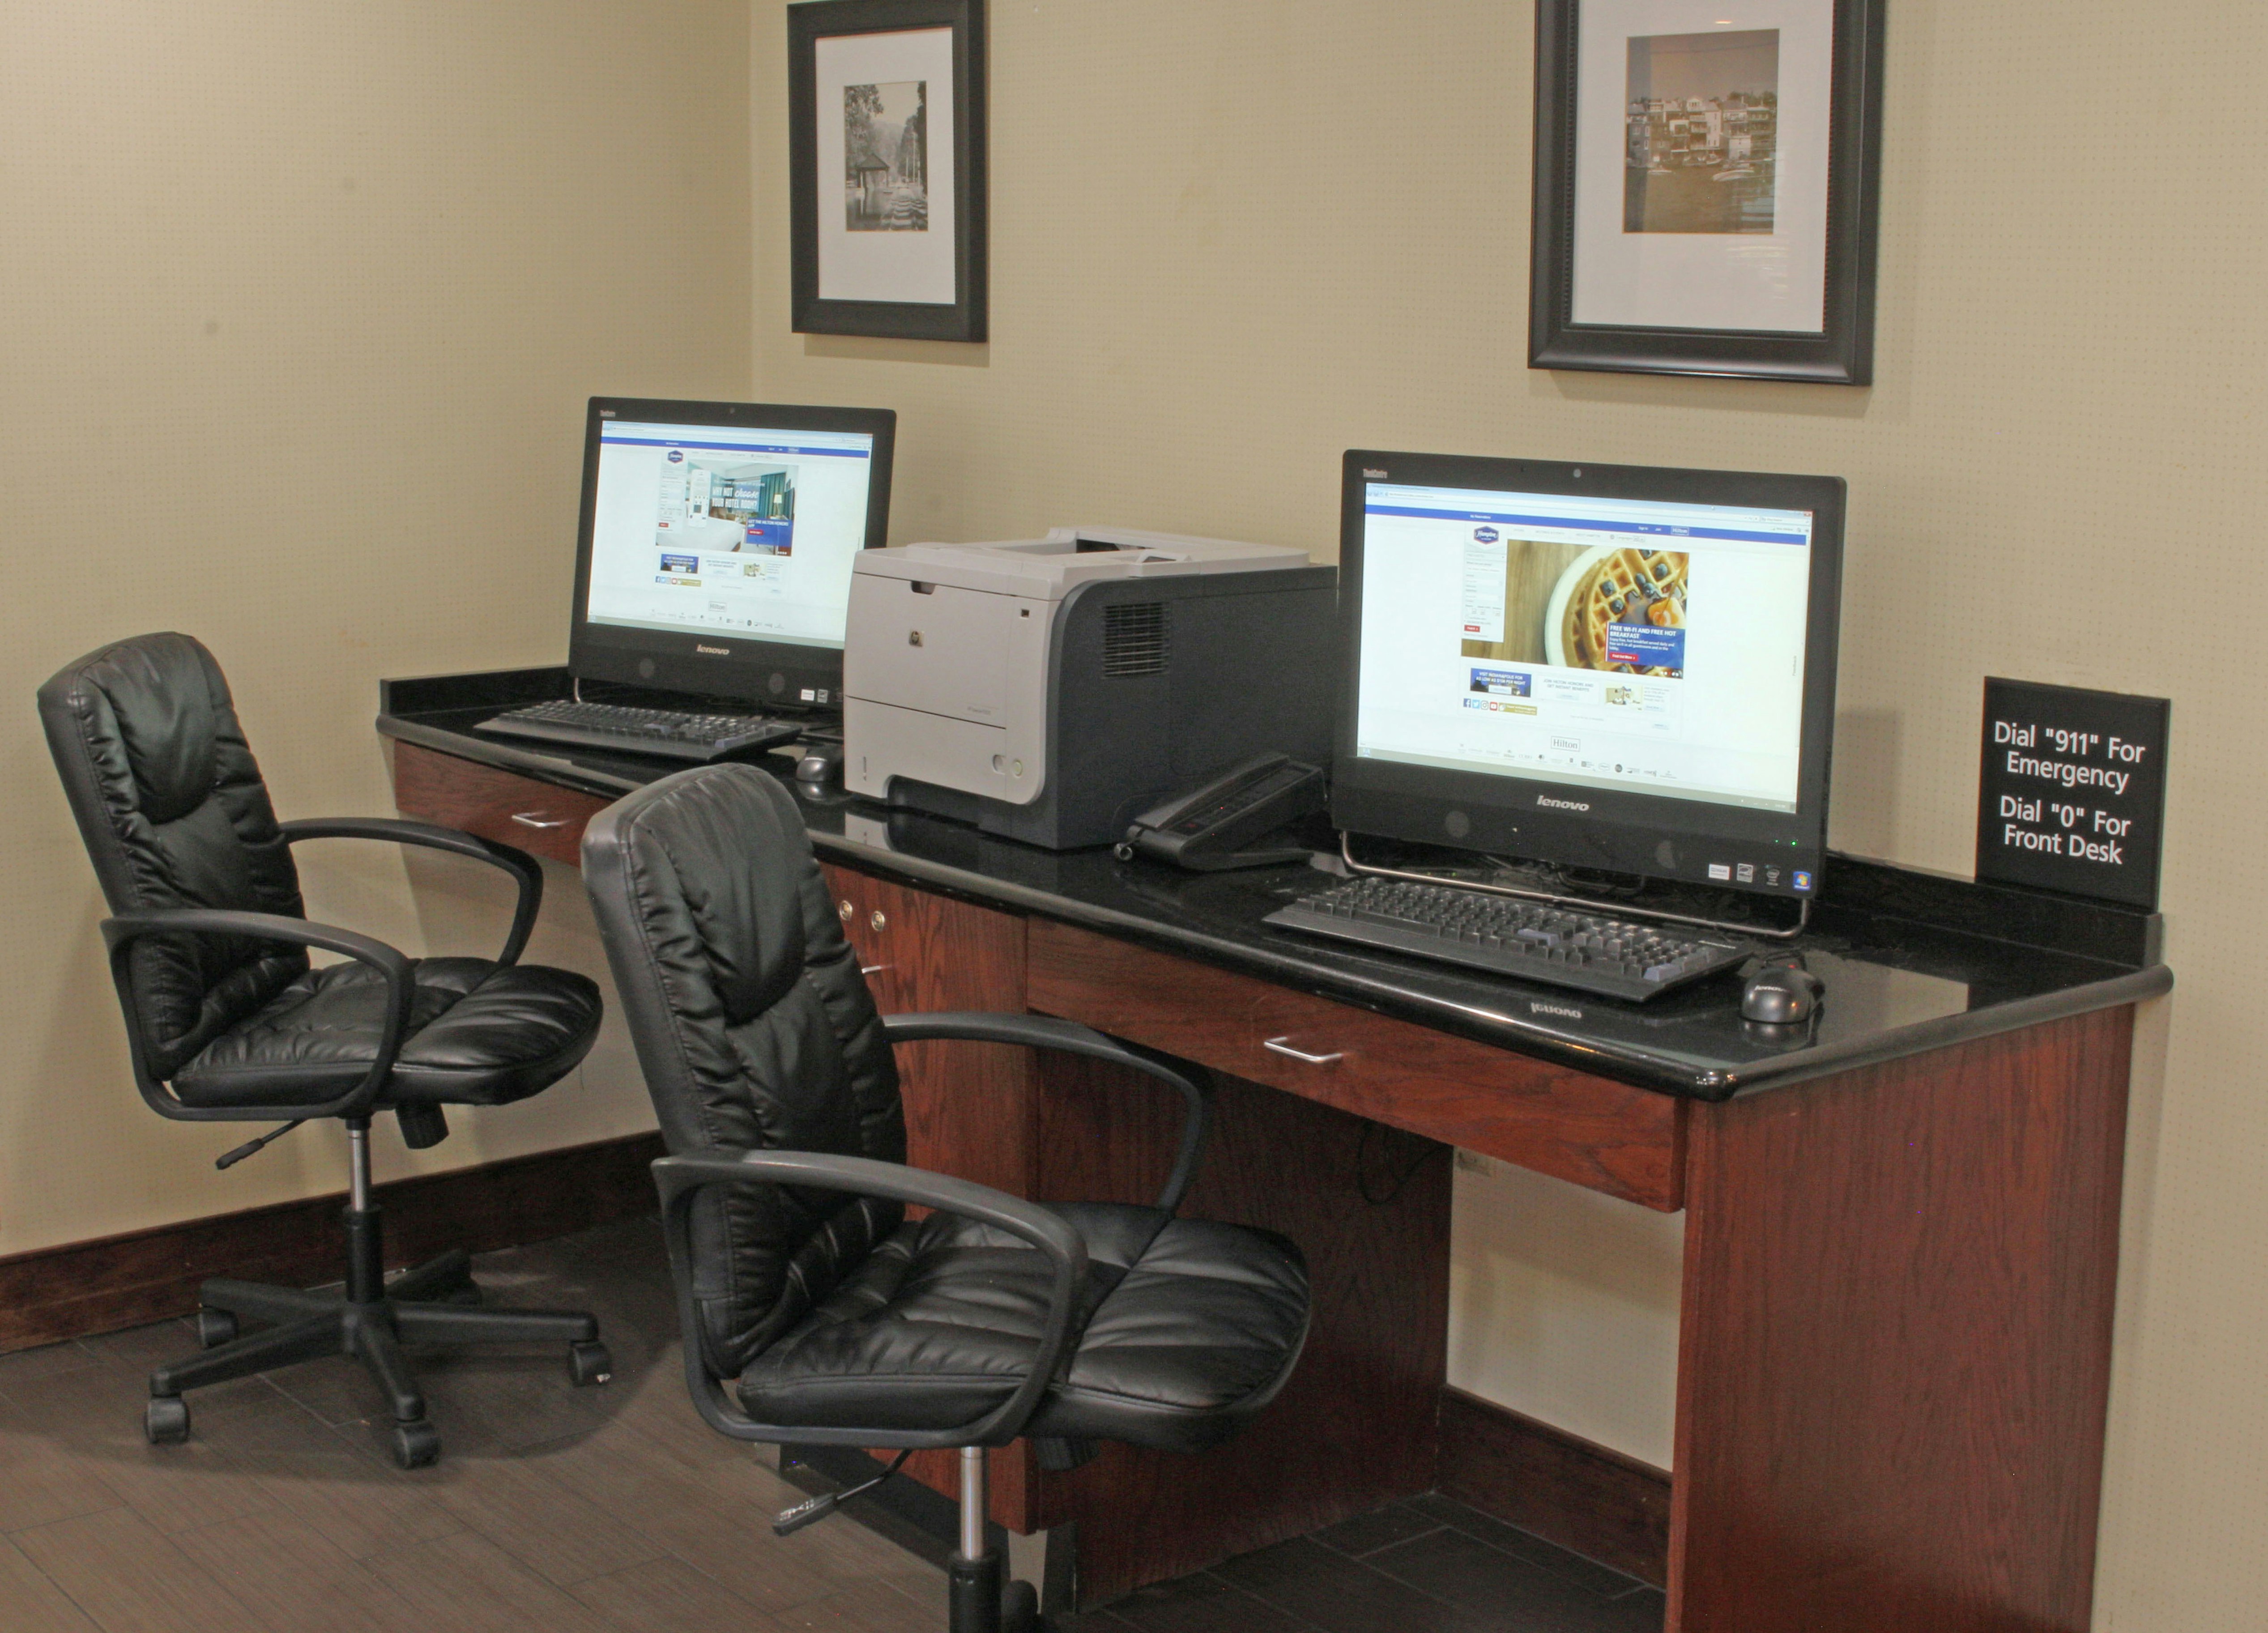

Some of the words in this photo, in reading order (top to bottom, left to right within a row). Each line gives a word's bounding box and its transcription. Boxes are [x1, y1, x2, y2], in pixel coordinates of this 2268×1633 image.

[734, 488, 759, 499] choose
[696, 644, 730, 655] lenovo
[1553, 739, 1578, 750] Hilton
[1995, 721, 2036, 748] Dial
[2046, 728, 2099, 755] "911"
[2108, 737, 2146, 763] For
[2007, 751, 2129, 795] Emergency
[1537, 795, 1590, 812] lenovo
[2000, 795, 2041, 822] Dial
[2051, 803, 2085, 827] "0"
[2094, 810, 2132, 837] For
[2004, 823, 2062, 854] Front
[2068, 834, 2123, 865] Desk
